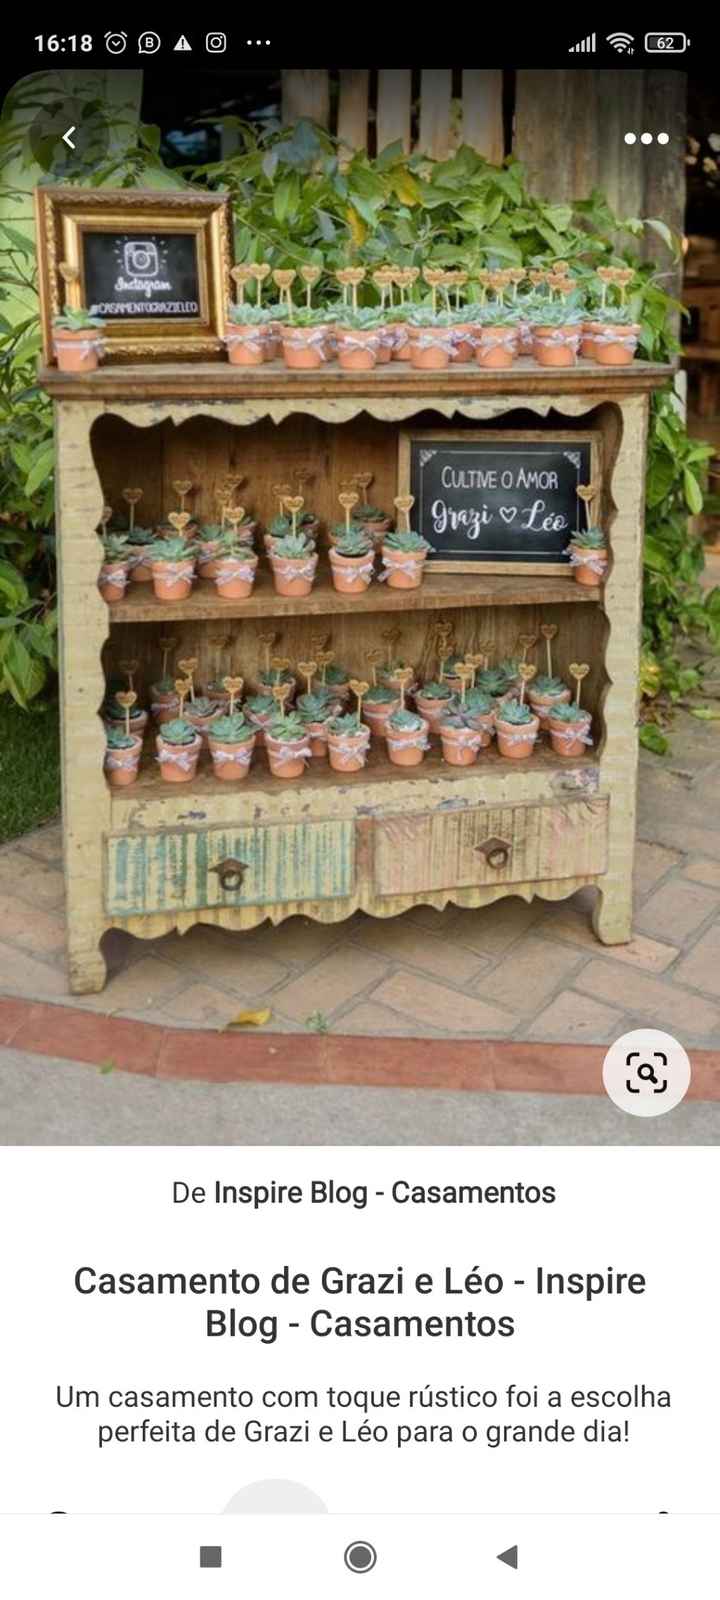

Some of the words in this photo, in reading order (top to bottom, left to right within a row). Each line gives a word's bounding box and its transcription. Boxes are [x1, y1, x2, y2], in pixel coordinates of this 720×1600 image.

[114, 276, 172, 298] Instagram
[501, 472, 514, 489] O
[521, 499, 568, 532] Léo
